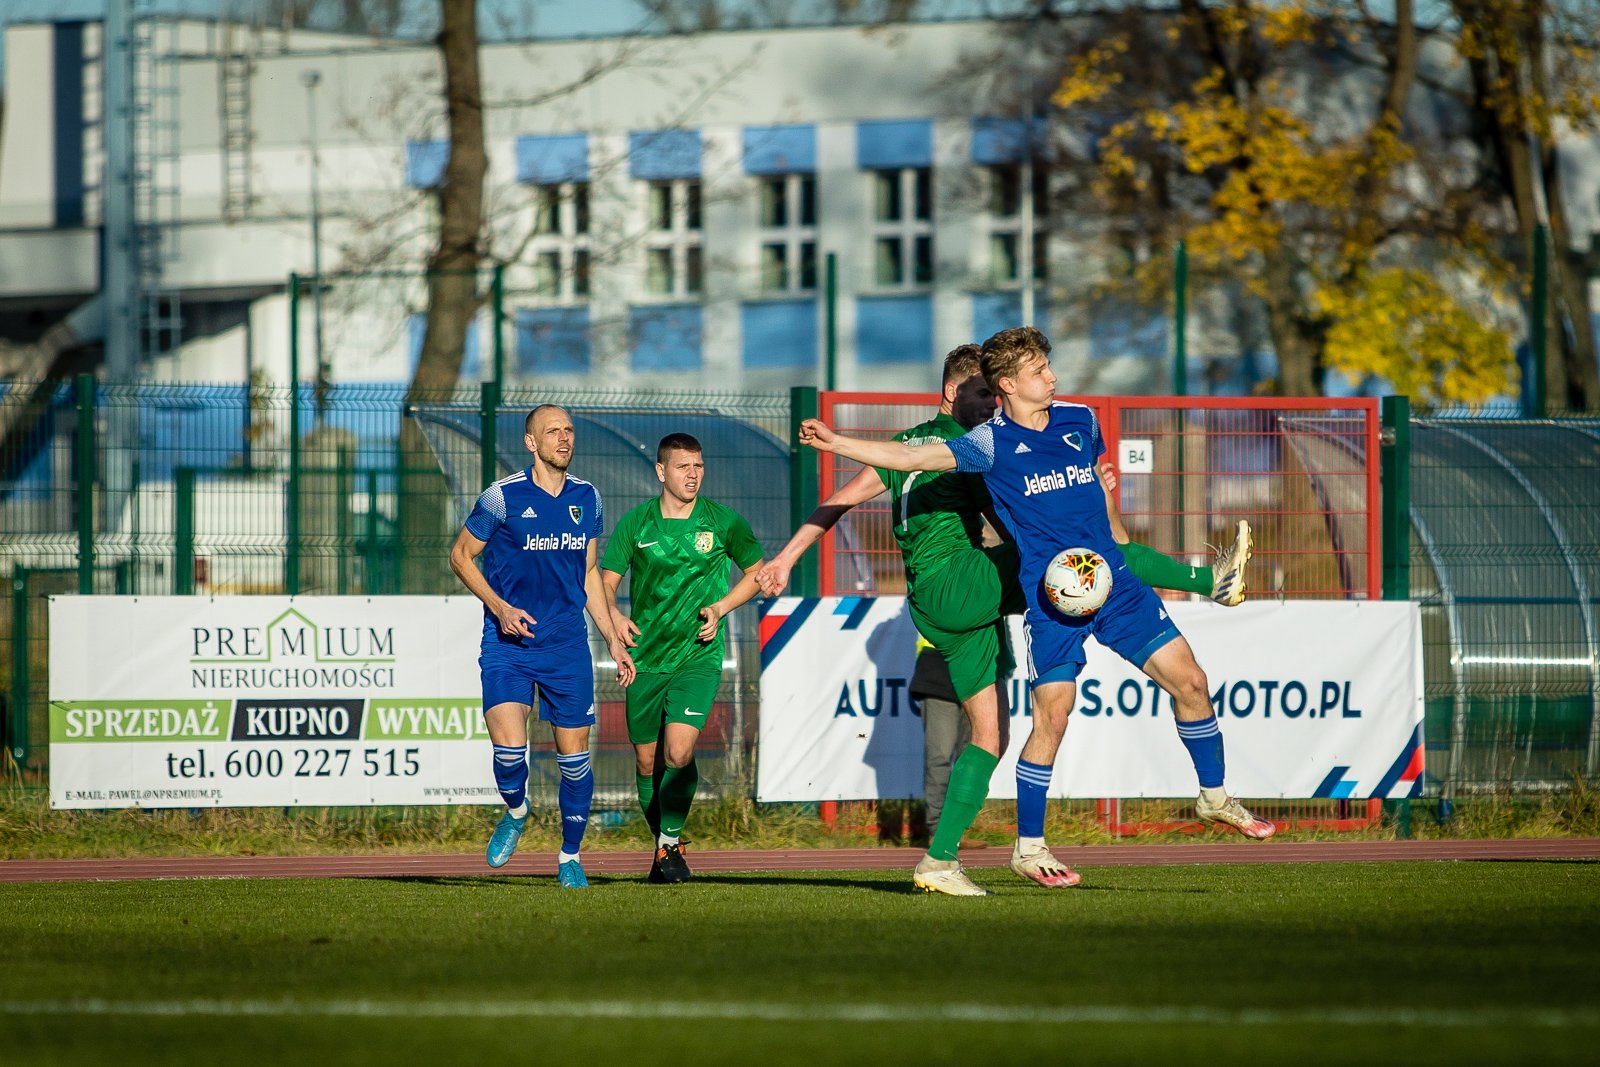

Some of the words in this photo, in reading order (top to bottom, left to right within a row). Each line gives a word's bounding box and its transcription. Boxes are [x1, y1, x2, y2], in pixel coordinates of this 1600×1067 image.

[1128, 450, 1145, 464] B4
[1023, 470, 1067, 497] Jelenia
[522, 533, 559, 551] Jelenia
[560, 532, 586, 550] Plast
[190, 626, 396, 657] PREMIUM
[191, 663, 395, 689] NIERUCHOMOŚCI
[65, 702, 220, 737] SPRZEDAŻ
[246, 706, 350, 736] KUPNO
[376, 706, 488, 740] WYNAJE
[166, 749, 216, 779] tel.
[224, 749, 284, 778] 600
[293, 748, 351, 778] 227
[363, 747, 421, 777] 515
[65, 790, 107, 801] E-MAIL:
